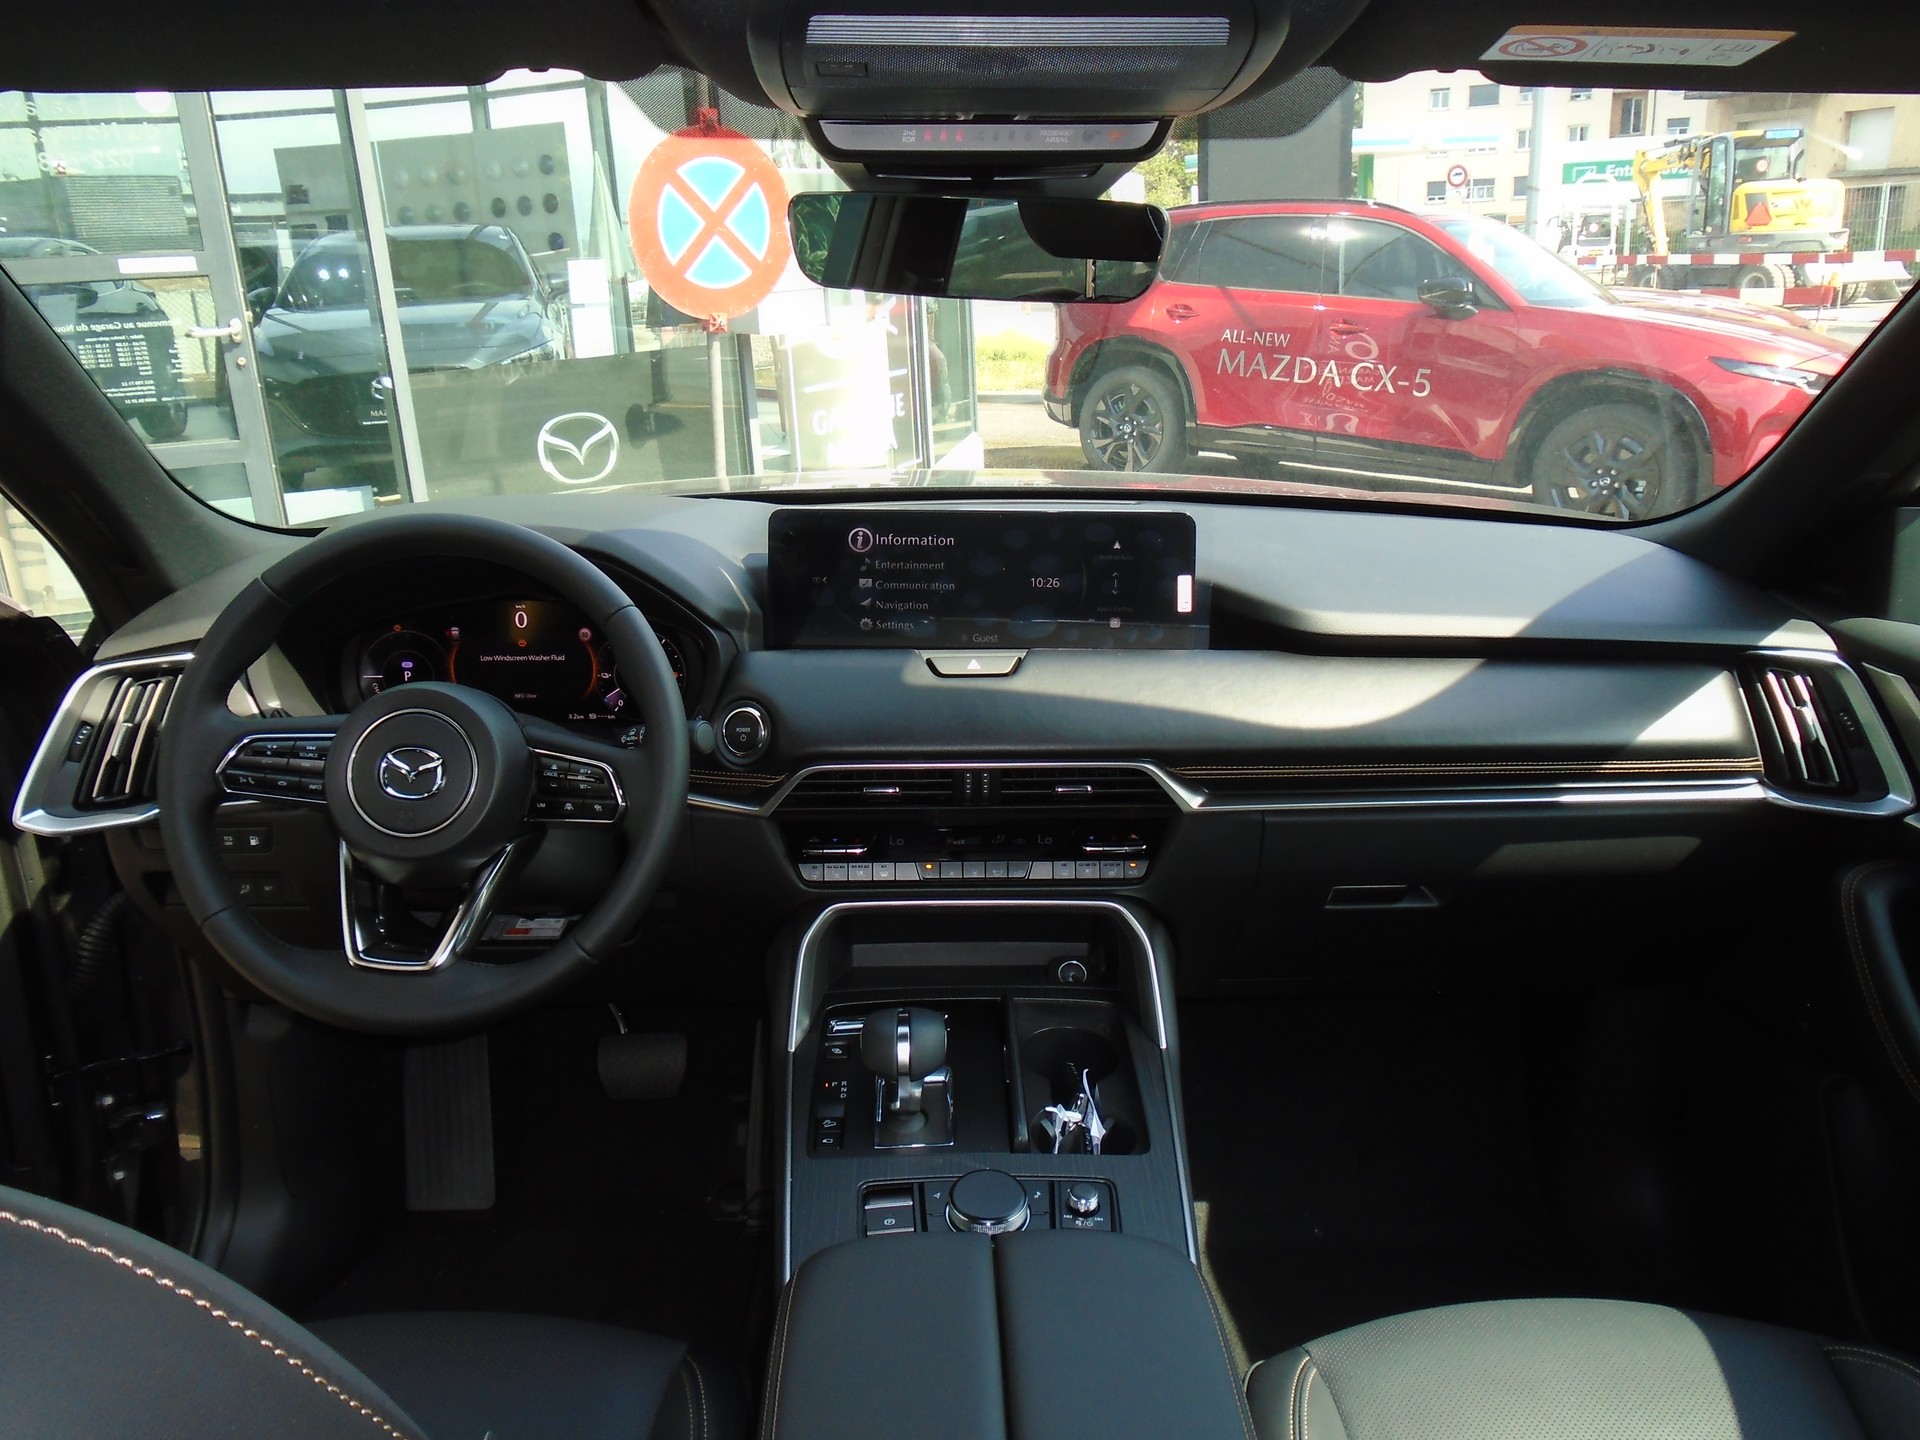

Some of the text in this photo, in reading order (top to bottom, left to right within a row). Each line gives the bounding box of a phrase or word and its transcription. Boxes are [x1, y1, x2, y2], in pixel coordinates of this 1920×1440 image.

[1220, 328, 1290, 348] ALL-NEW
[1216, 348, 1432, 398] MAZDA CX-5
[875, 532, 955, 547] Information
[875, 559, 945, 571] Entertainment
[875, 580, 956, 591] Communication
[1030, 576, 1060, 588] 10:26
[876, 600, 929, 613] Navigation
[515, 611, 528, 628] 0
[876, 618, 914, 632] Settings
[972, 633, 998, 644] Guest
[404, 671, 412, 682] P
